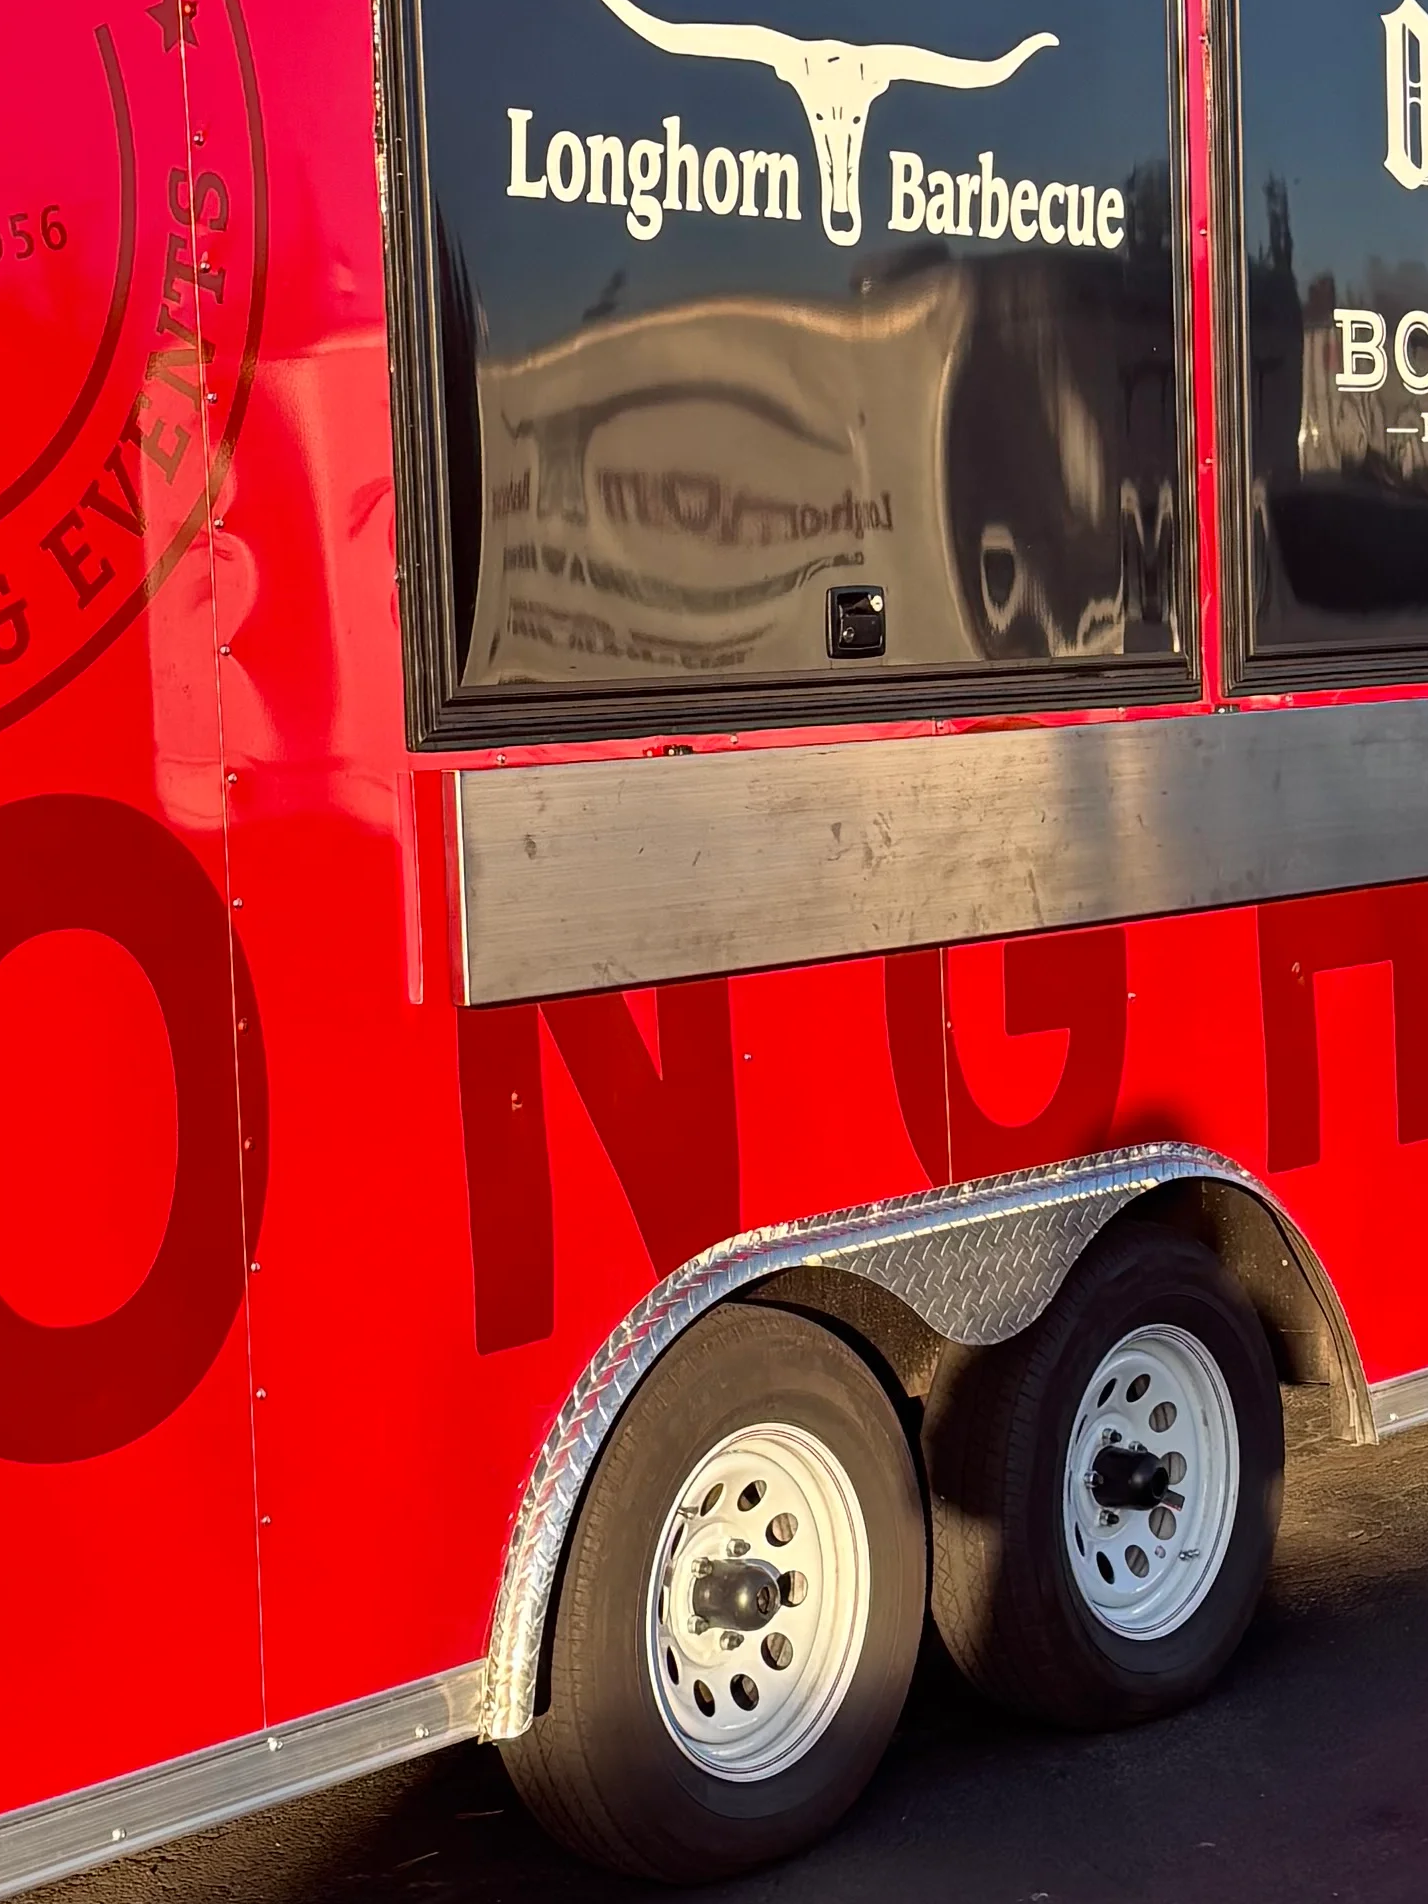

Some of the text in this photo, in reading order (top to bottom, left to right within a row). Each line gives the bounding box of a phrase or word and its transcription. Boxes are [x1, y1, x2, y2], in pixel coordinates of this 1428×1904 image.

[506, 107, 1125, 250] Longhorn Barbecue
[37, 162, 230, 612] EVENTS
